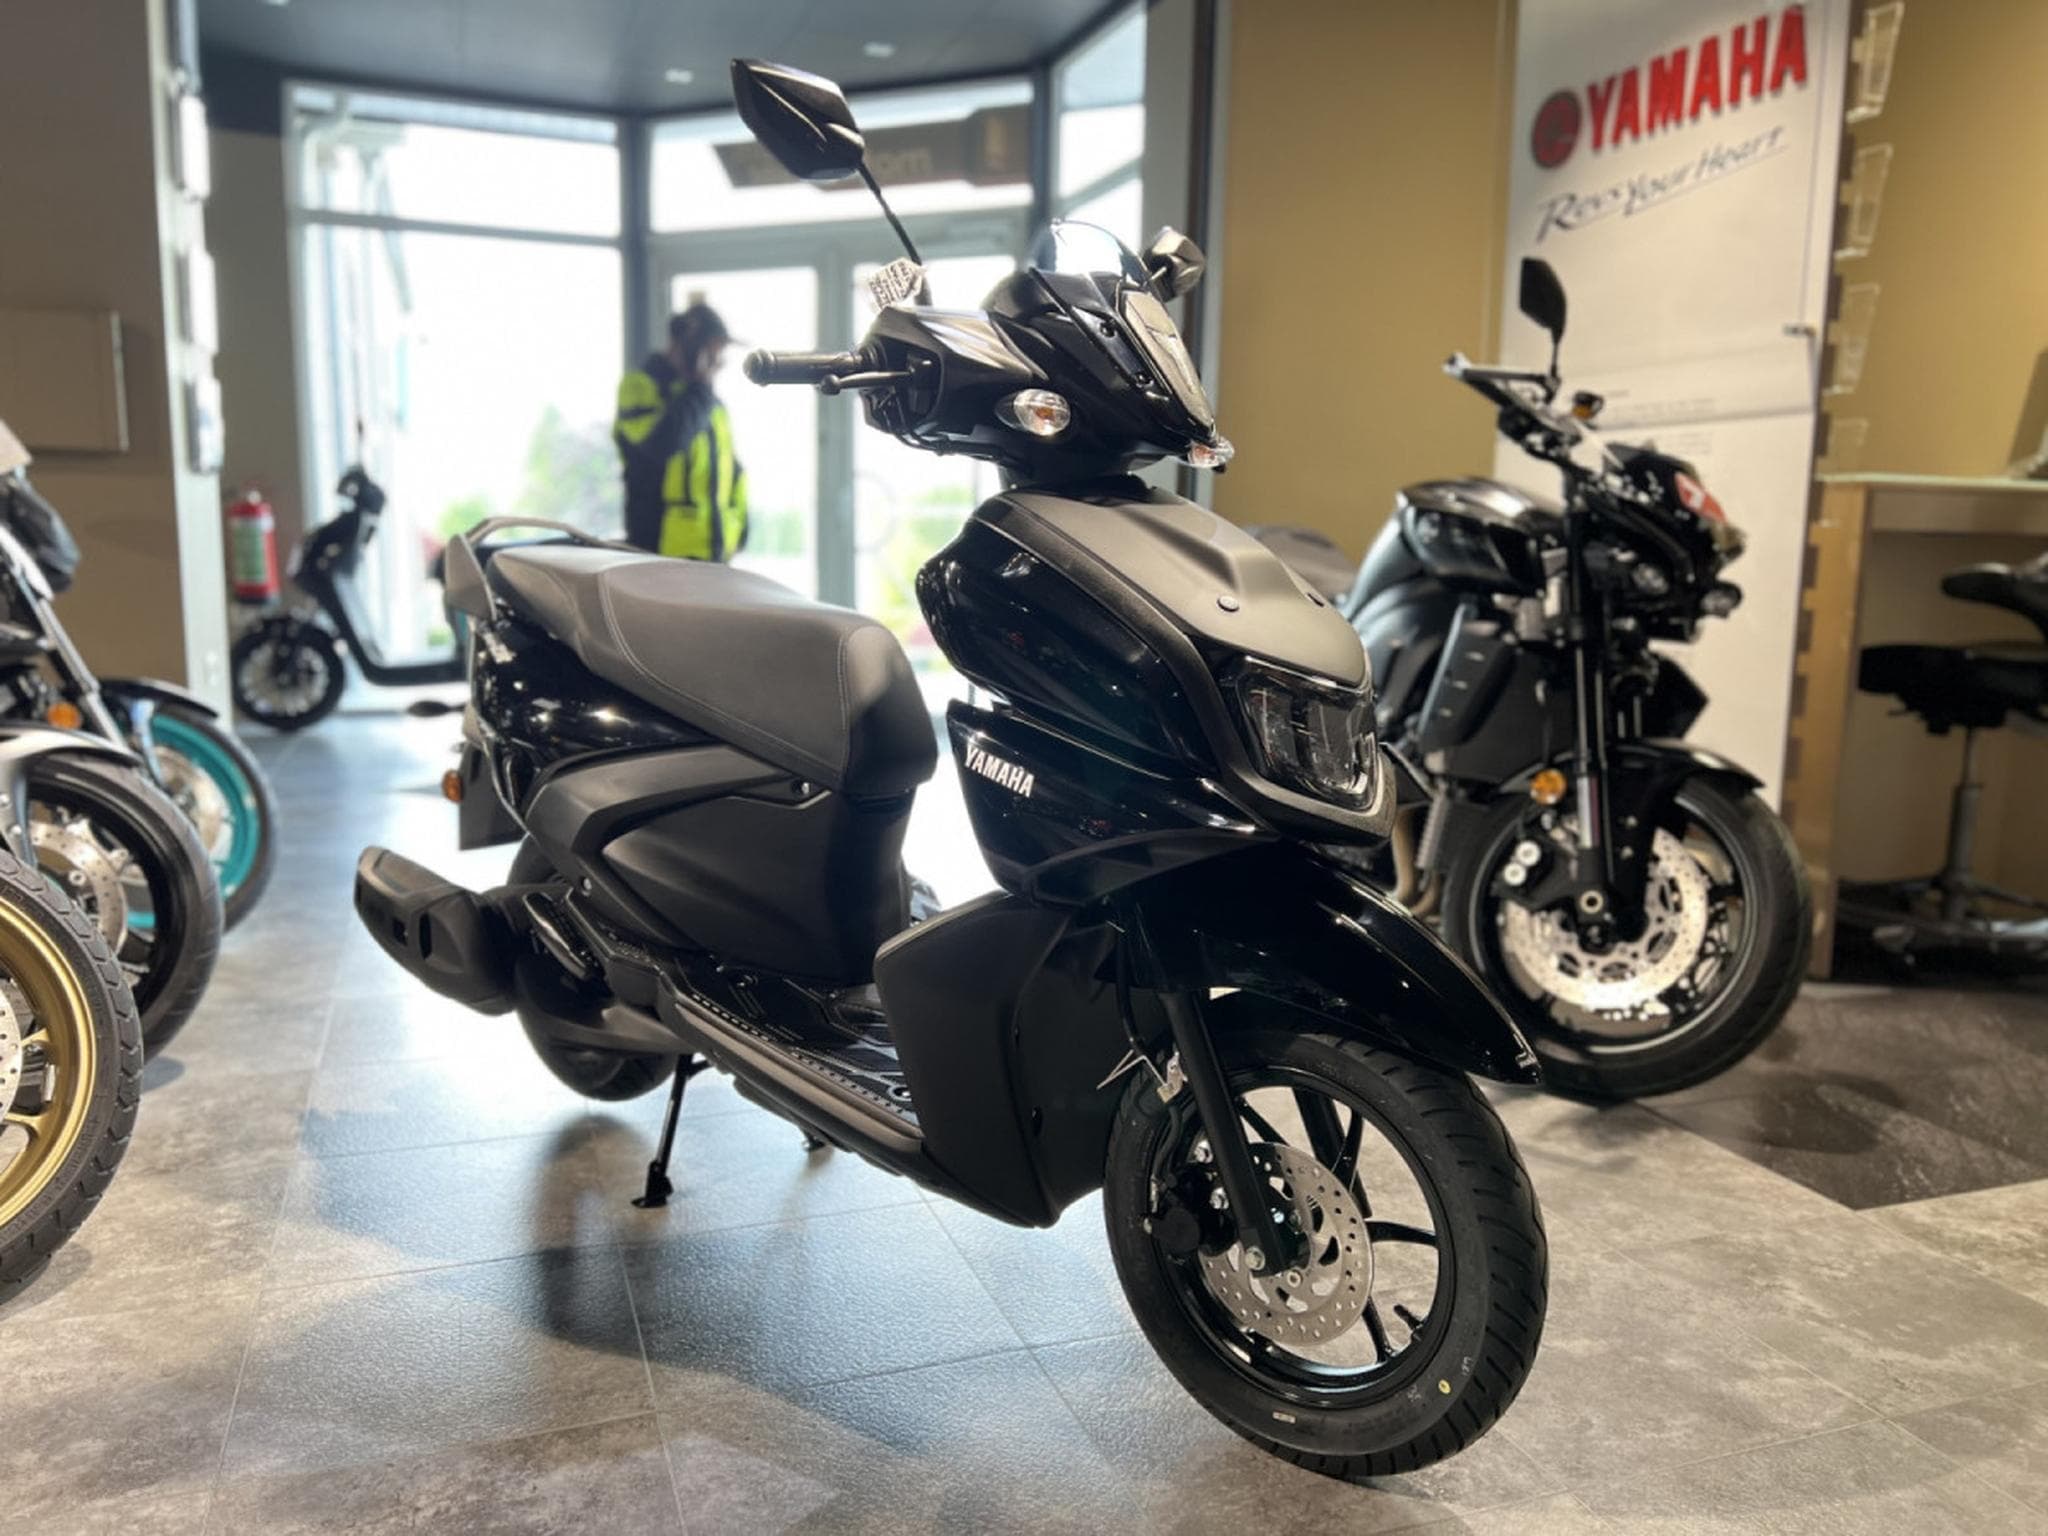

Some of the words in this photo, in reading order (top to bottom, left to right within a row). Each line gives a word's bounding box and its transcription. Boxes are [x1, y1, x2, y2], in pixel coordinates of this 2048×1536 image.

[1587, 4, 1807, 152] YAMAHA
[1624, 163, 1692, 216] Your
[1696, 126, 1784, 178] Heart
[965, 743, 1034, 797] YAMAHA
